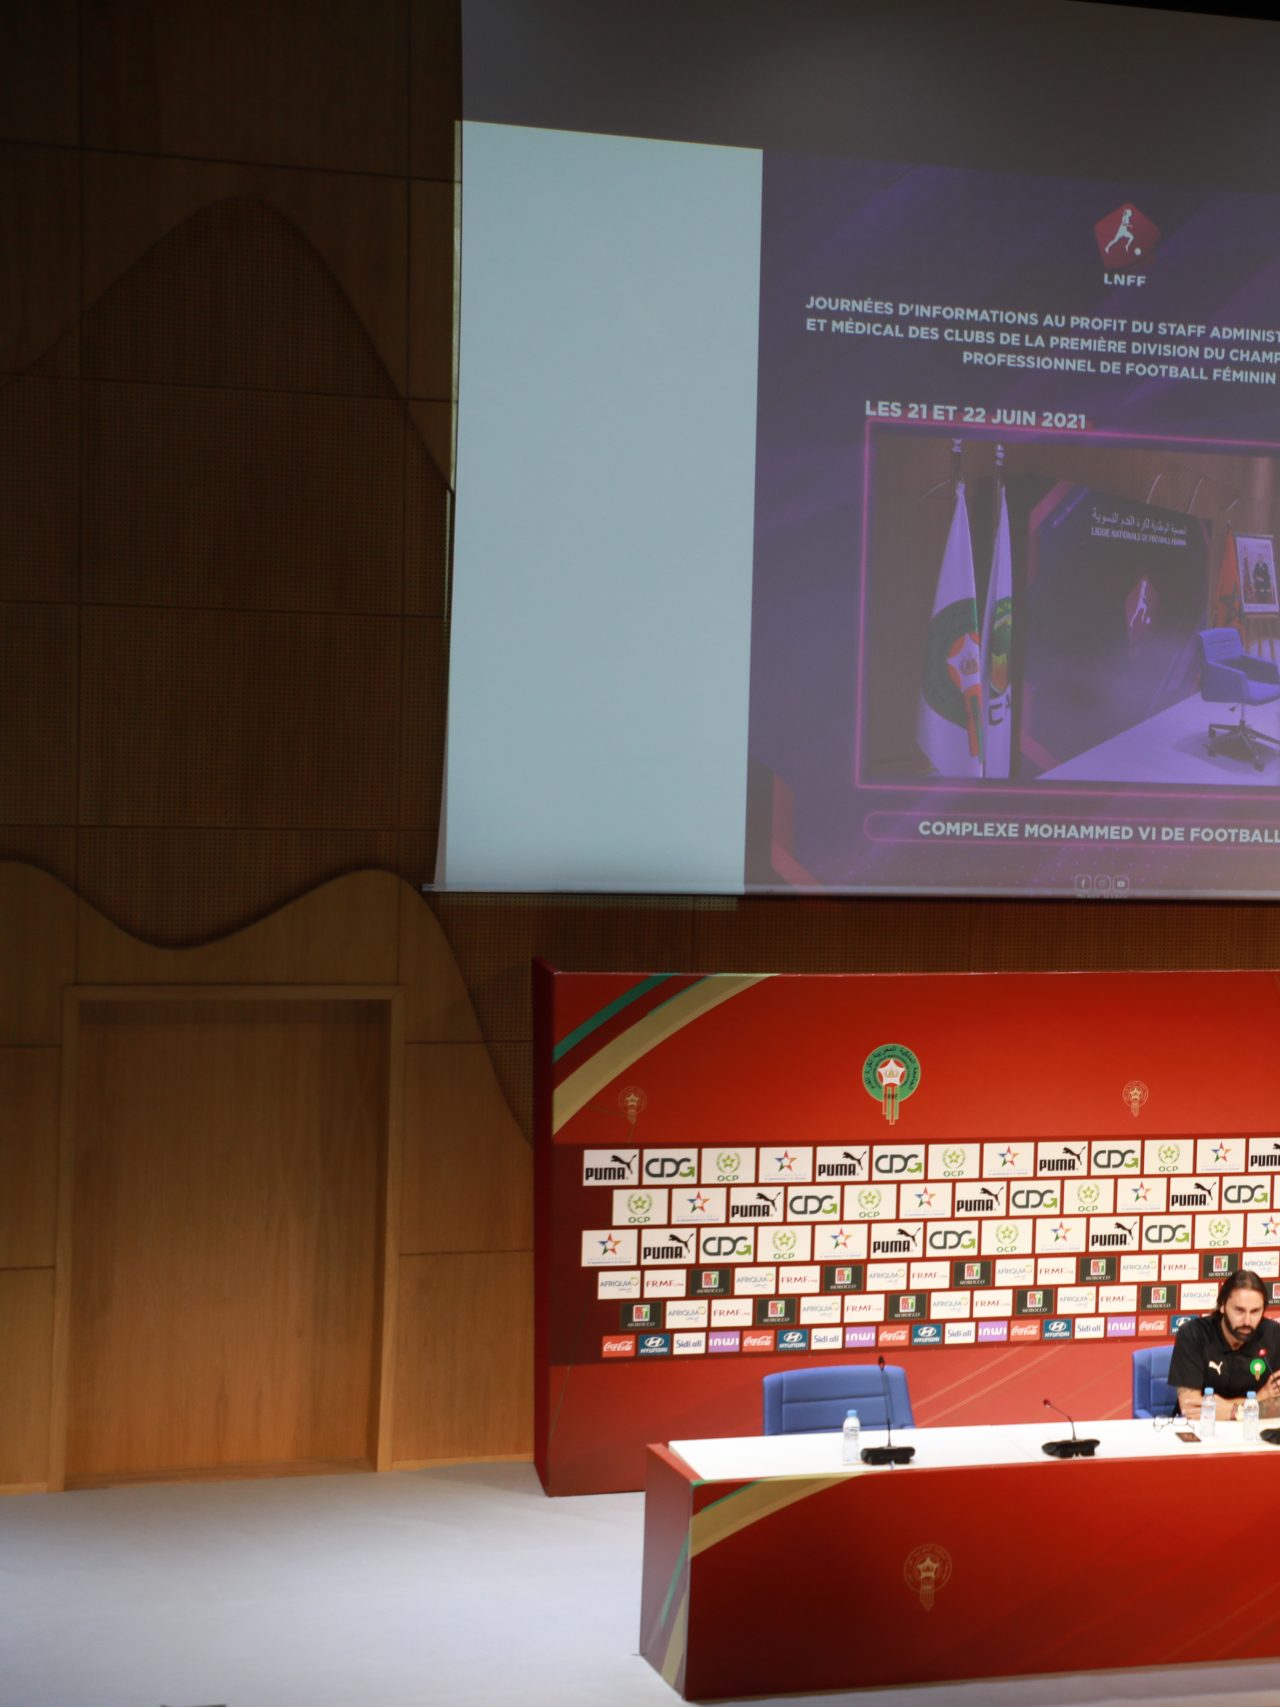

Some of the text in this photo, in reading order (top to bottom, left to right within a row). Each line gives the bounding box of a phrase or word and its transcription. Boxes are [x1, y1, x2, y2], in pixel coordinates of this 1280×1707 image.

[1104, 273, 1146, 287] LNFF
[806, 296, 894, 314] JOURNÉES
[898, 304, 1038, 325] D'INFORMATIONS
[1043, 314, 1065, 327] AU
[1070, 318, 1127, 332] PROFIT
[1132, 321, 1154, 333] DU
[1158, 323, 1206, 337] STAFF
[806, 319, 827, 331] ET
[832, 318, 904, 337] MÉDICAL
[909, 327, 939, 340] DES
[944, 329, 995, 344] CLUBS
[1000, 333, 1021, 346] DE
[1025, 335, 1045, 348] LA
[1050, 337, 1126, 353] PREMIÈRE
[1132, 343, 1200, 358] DIVISION
[1204, 348, 1224, 360] DU
[963, 352, 1276, 384] PROFESSIONNEL DE FOOTBALL FÉMININ
[866, 400, 1086, 428] LES 21 ET 22 JUIN 2021
[918, 821, 1019, 837] COMPLEXE
[1025, 824, 1133, 840] MOHAMMED
[1139, 826, 1156, 840] VI
[1162, 827, 1184, 842] DE
[818, 1163, 856, 1176] PUMA
[1039, 1159, 1075, 1171] PUMA
[585, 1167, 625, 1180] PUMA
[956, 1199, 993, 1212] PUMA
[1171, 1194, 1207, 1206] PUMA
[731, 1204, 770, 1218] PUMA
[873, 1240, 910, 1253] PUMA
[1091, 1234, 1127, 1246] PUMA
[643, 1246, 683, 1260] PUMA
[913, 1336, 942, 1344] HYUNDAI
[1044, 1330, 1071, 1339] HYUNDAI
[778, 1341, 806, 1349] HYUNDAI
